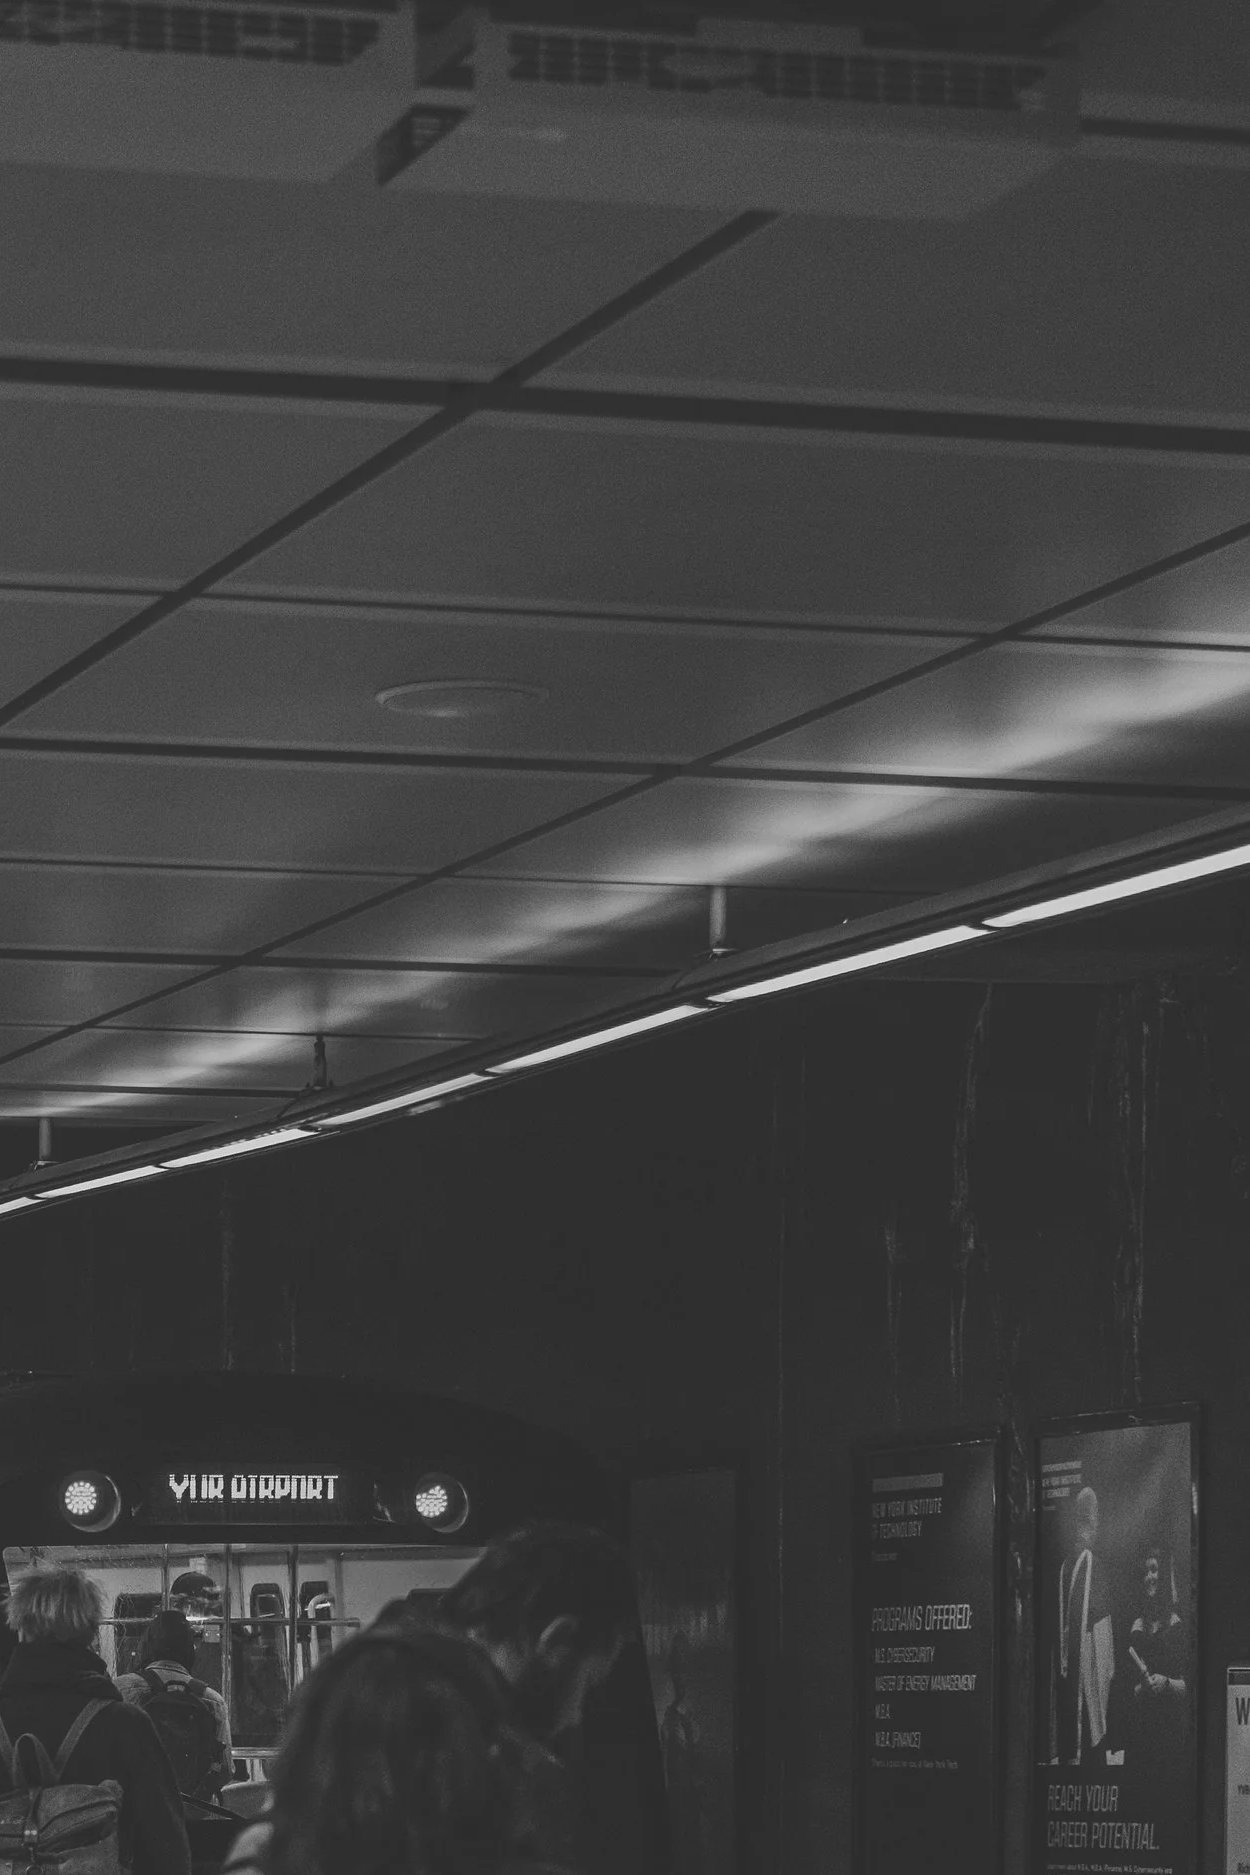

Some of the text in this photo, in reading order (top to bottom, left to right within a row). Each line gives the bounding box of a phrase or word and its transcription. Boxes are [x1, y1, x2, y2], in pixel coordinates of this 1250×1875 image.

[907, 1498, 942, 1515] INSTITUTE
[879, 1520, 922, 1539] TECHNOLOGY
[871, 1603, 972, 1632] PROGRAMS OFFERED:
[930, 1674, 977, 1691] MANAGEMENT
[1047, 1784, 1119, 1813] REACH YOUR
[1047, 1820, 1161, 1851] CAREER POTENTIAL.
